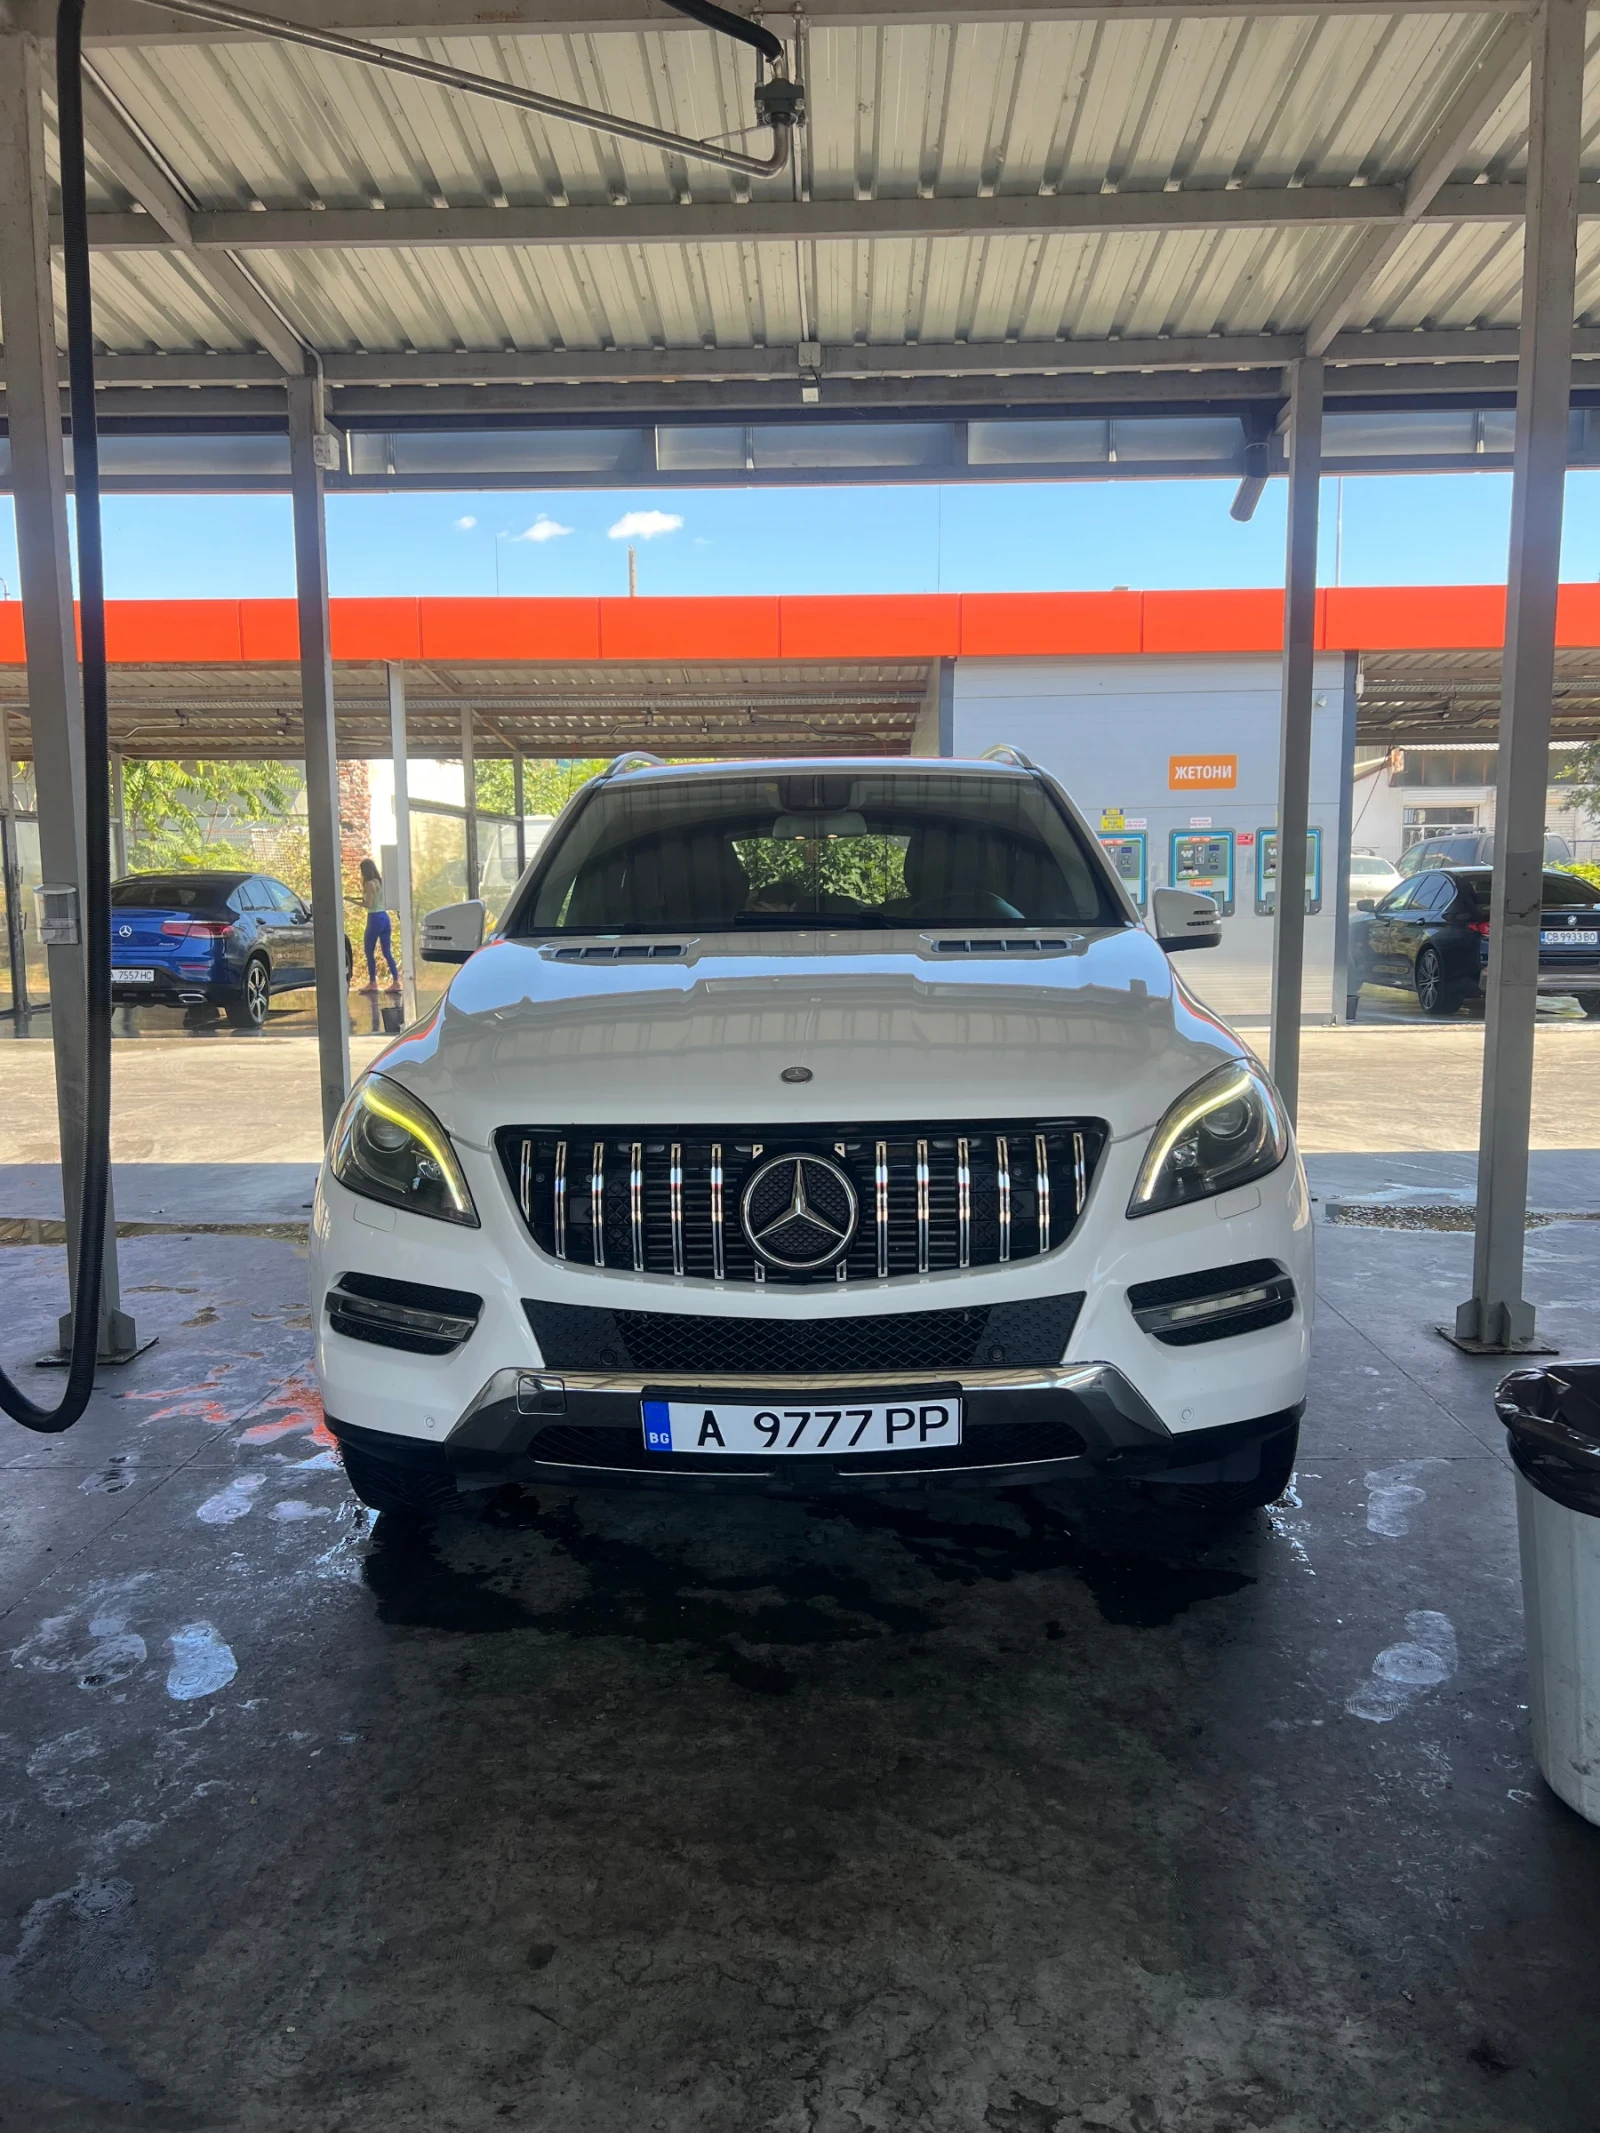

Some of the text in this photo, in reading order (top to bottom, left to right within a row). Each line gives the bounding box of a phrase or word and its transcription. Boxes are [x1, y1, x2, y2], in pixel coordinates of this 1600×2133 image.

[1174, 765, 1232, 780] ЖЕТОНИ
[1560, 932, 1582, 942] 9933
[118, 970, 139, 980] 7557
[140, 970, 152, 980] HC
[697, 1405, 949, 1448] A 9777 PP
[649, 1432, 670, 1445] BG
